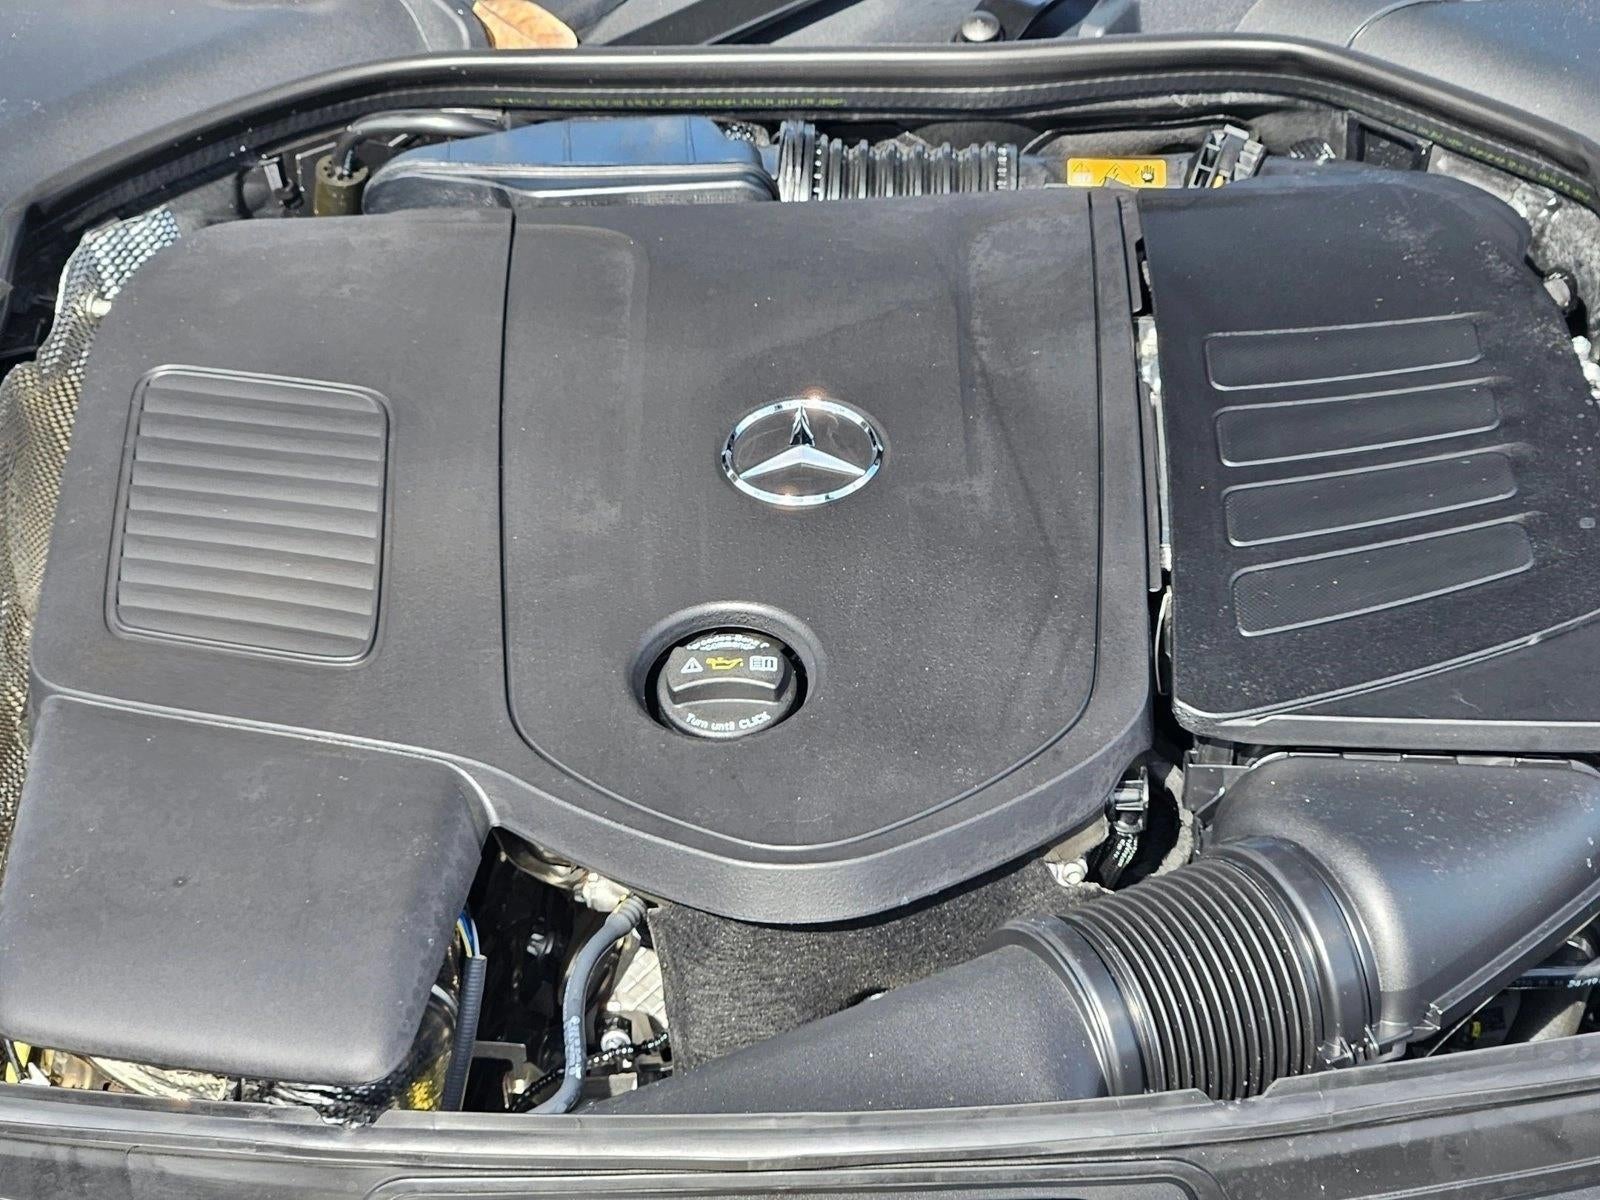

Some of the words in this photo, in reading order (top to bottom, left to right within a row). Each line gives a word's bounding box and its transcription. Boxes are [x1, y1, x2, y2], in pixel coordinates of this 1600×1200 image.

[686, 713, 709, 729] Turn
[711, 721, 735, 731] until
[739, 711, 771, 730] CLICK
